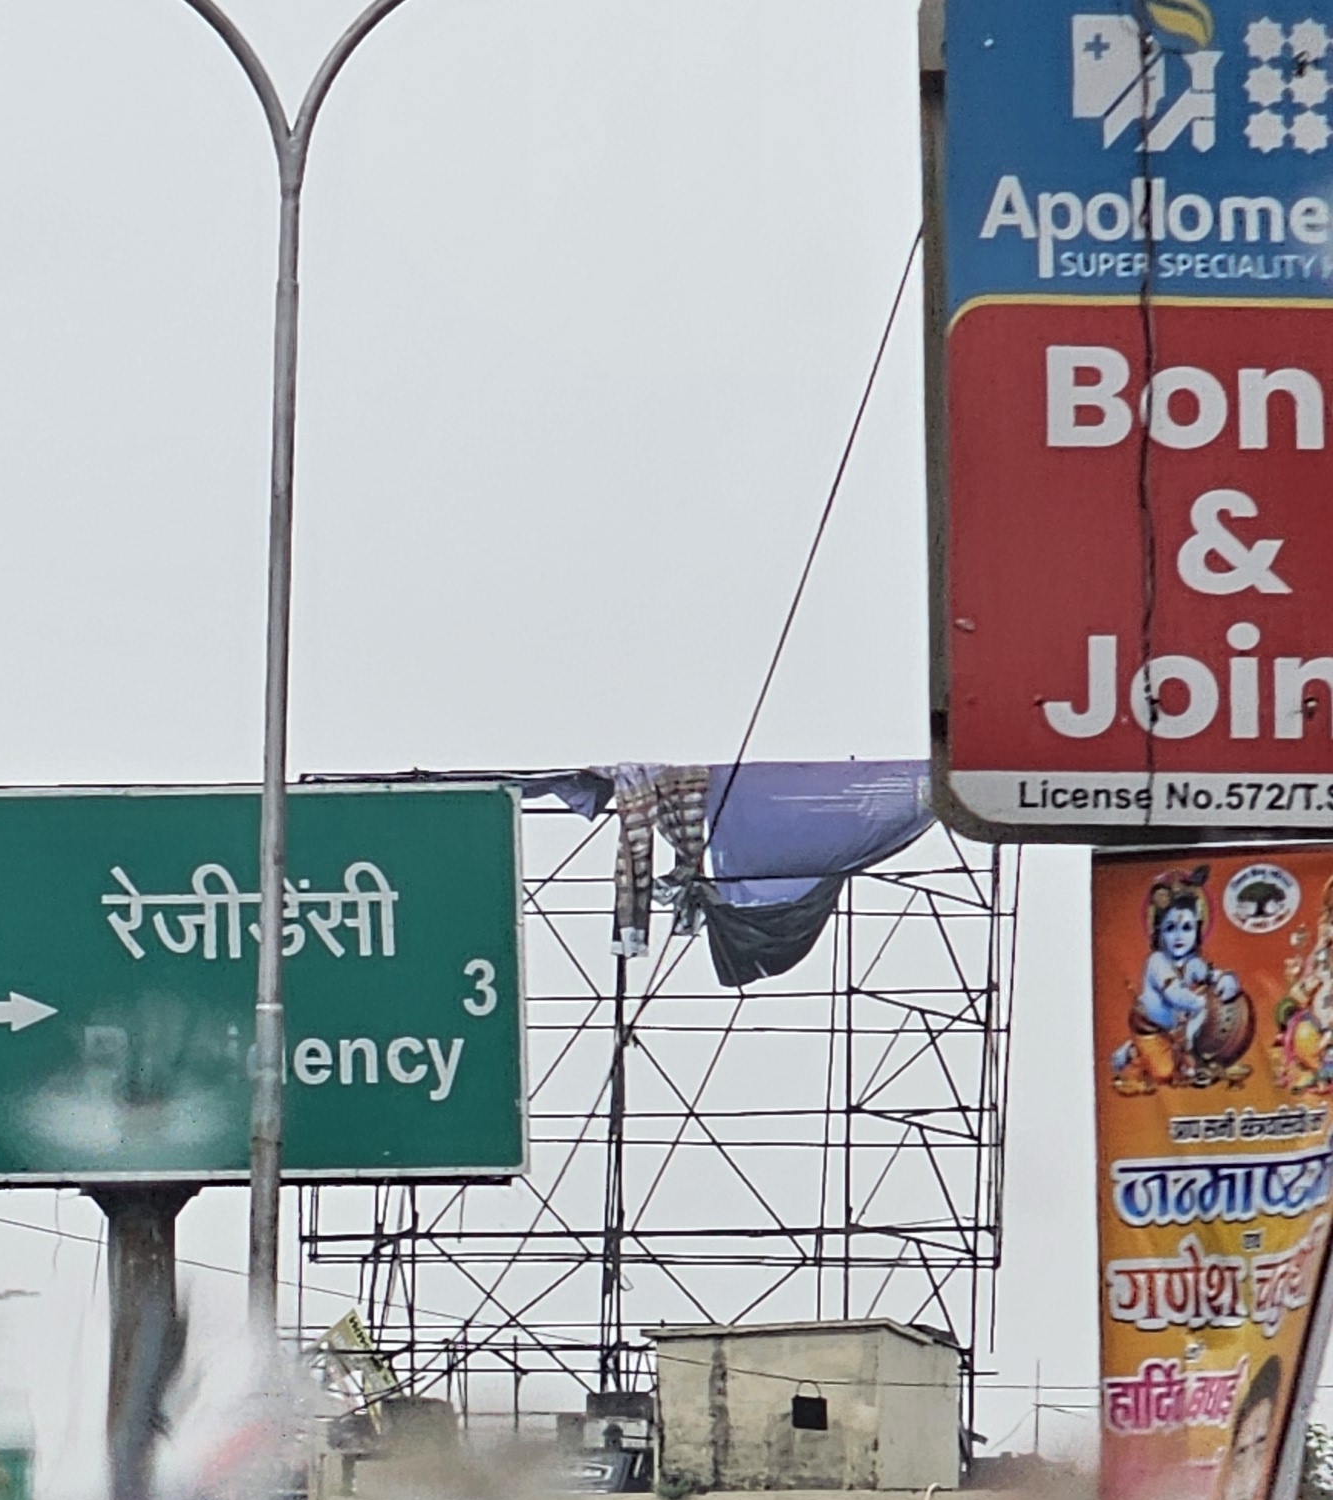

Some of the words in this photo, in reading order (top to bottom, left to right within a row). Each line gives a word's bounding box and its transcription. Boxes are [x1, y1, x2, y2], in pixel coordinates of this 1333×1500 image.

[1177, 489, 1293, 595] &
[1018, 780, 1152, 809] License
[463, 958, 498, 1017] 3
